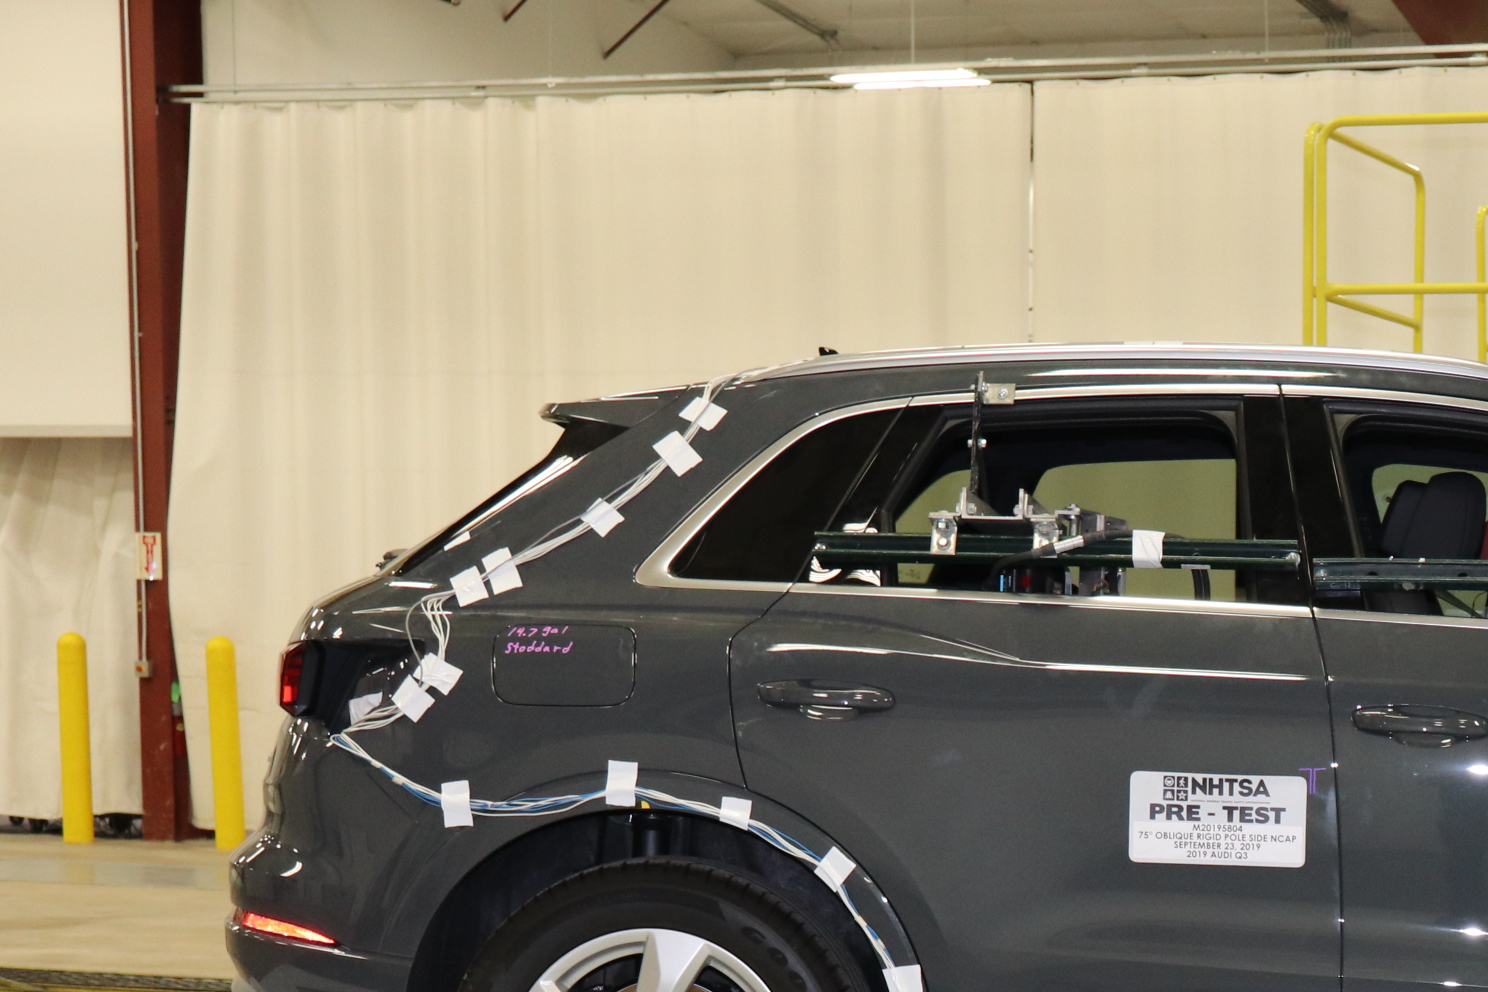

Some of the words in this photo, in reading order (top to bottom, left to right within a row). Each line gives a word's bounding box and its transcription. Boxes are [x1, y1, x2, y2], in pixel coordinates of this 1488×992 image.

[542, 626, 569, 637] gal
[505, 641, 573, 654] Stoddard
[1191, 776, 1271, 798] NHTSA
[1149, 803, 1201, 822] PRE
[1222, 806, 1286, 824] TEST
[1192, 824, 1243, 833] M20195804
[1138, 831, 1153, 839] 75°
[1155, 832, 1194, 841] OBLIQUE
[1197, 833, 1221, 841] RIGID
[1224, 833, 1246, 841] POLE
[1249, 834, 1268, 842] SIDE
[1271, 834, 1296, 843] NCAP
[1174, 841, 1221, 850] SEPTEMBER
[1224, 843, 1237, 851] 23,
[1240, 843, 1261, 851] 2019
[1186, 851, 1208, 859] 2019
[1211, 851, 1232, 859] AUDI
[1235, 852, 1248, 860] Q3
